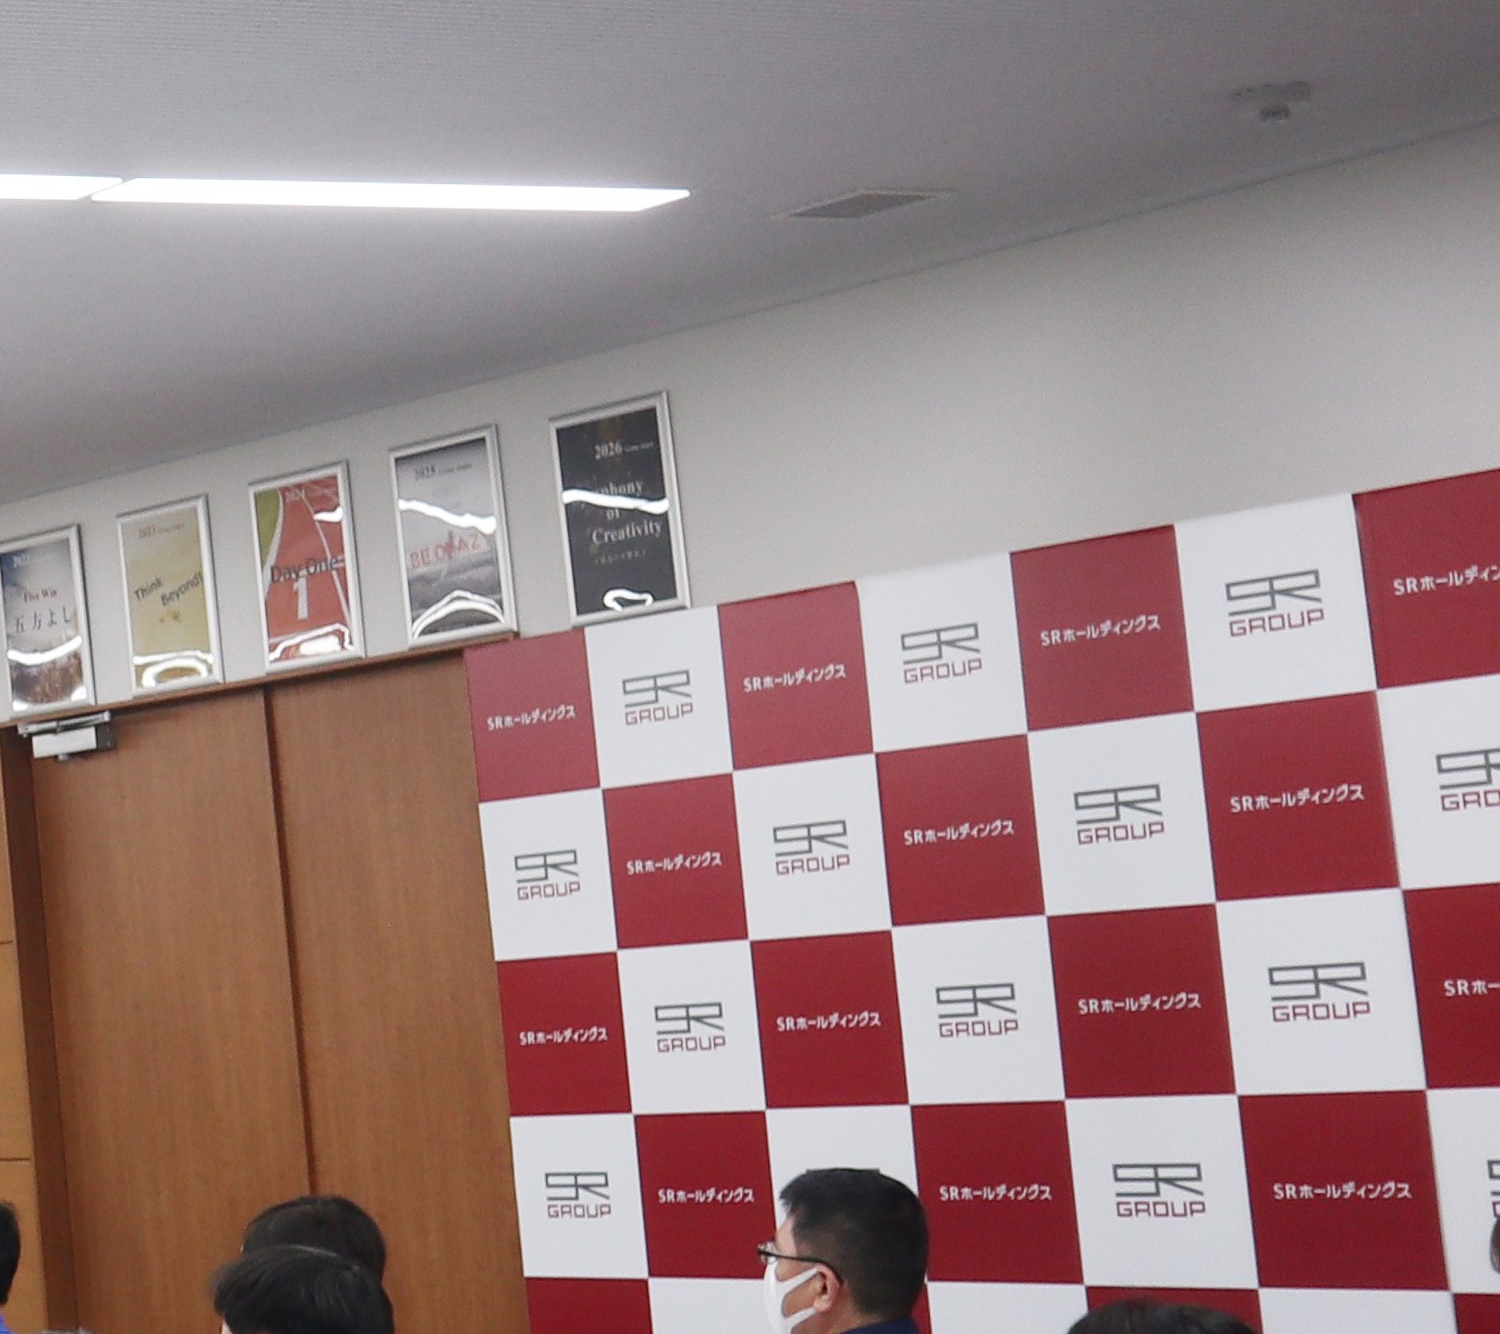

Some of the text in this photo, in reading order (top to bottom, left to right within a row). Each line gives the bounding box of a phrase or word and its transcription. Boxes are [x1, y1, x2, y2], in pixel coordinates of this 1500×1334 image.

[592, 519, 662, 544] Creativity
[134, 578, 162, 602] Think
[1039, 614, 1161, 647] SRホールディングス
[1229, 608, 1324, 638] GROUP
[743, 663, 846, 693] SRホールディングス
[905, 658, 982, 684] GROUP
[486, 704, 576, 731] SRホールディングス
[628, 704, 693, 726] GROUP
[1229, 783, 1365, 813] SRホールディングス
[1440, 781, 1500, 812] GRO
[903, 818, 1015, 846] SRホールディングス
[1078, 822, 1164, 845] GROUP
[626, 850, 722, 876] SRホールディングス
[776, 854, 850, 876] GROUP
[517, 882, 580, 901] GROUP
[1077, 991, 1201, 1015] SRホールディングス
[1272, 1002, 1370, 1023] GROUP
[776, 1010, 881, 1032] SRホールディングス
[940, 1019, 1018, 1038] GROUP
[519, 1025, 608, 1046] SRホールディングス
[659, 1036, 725, 1053] GROUP
[657, 1186, 755, 1204] SRホールディングス
[939, 1183, 1053, 1201] SRホールディングス
[1273, 1180, 1412, 1200] SRホールディングス
[548, 1204, 611, 1219] GROUP
[1116, 1201, 1205, 1218] GROUP
